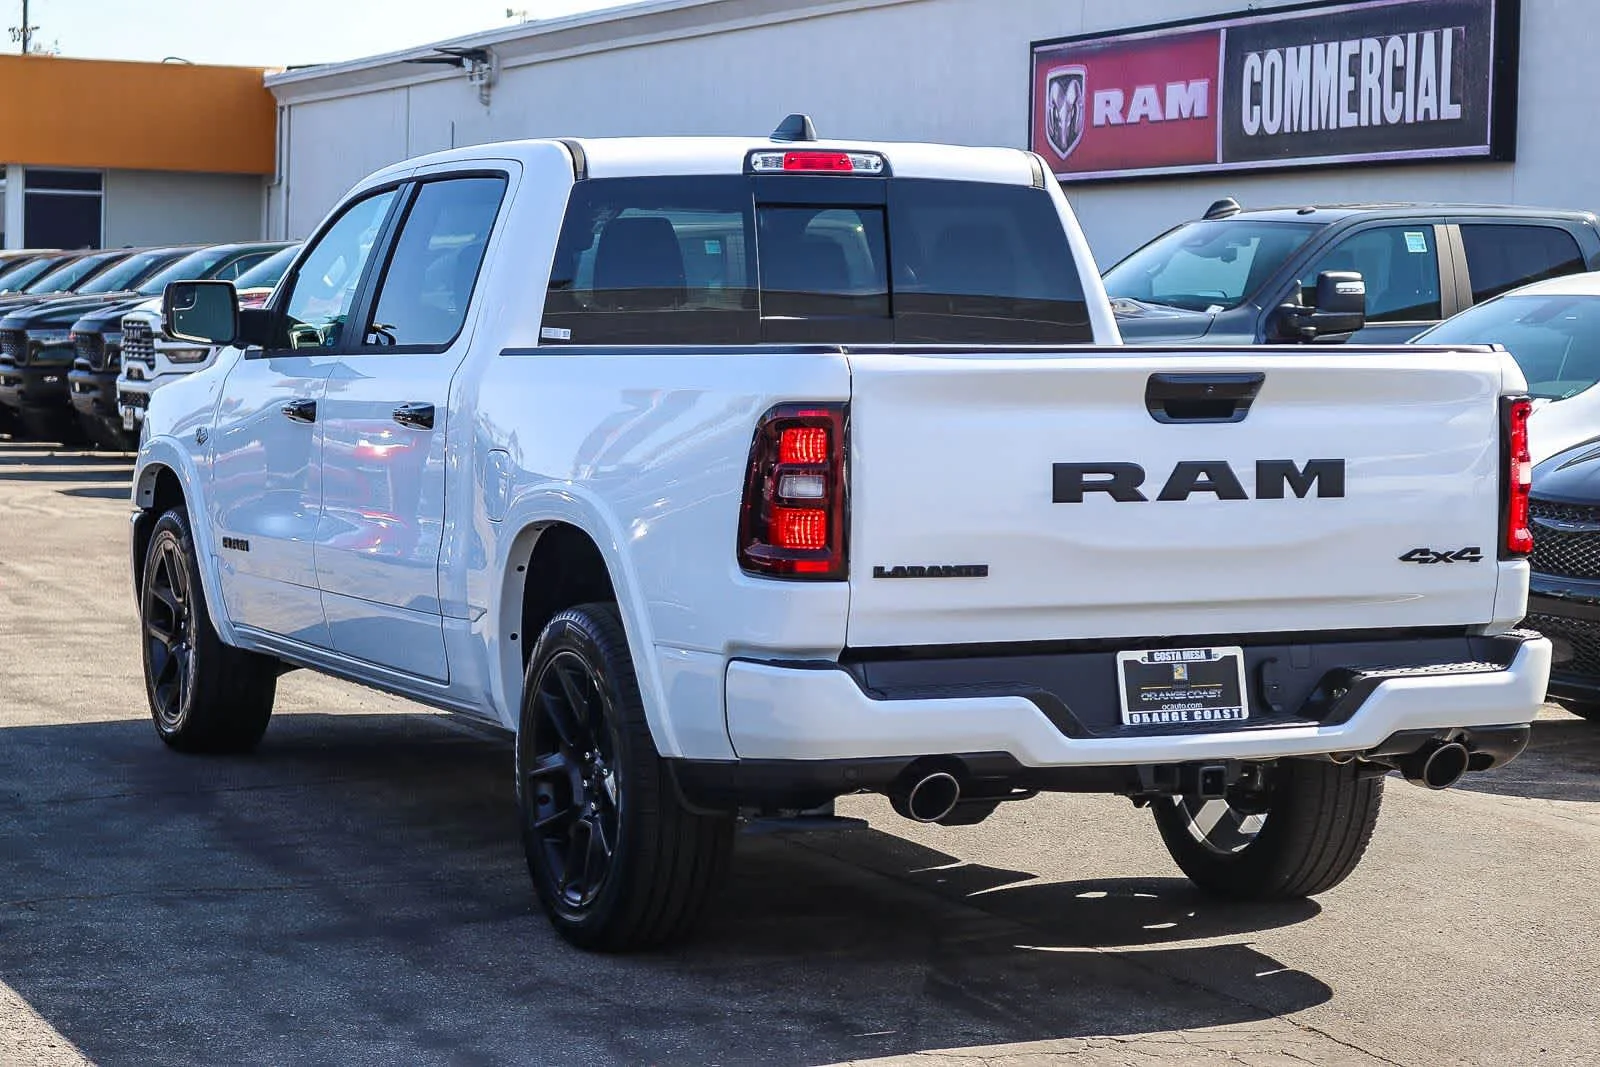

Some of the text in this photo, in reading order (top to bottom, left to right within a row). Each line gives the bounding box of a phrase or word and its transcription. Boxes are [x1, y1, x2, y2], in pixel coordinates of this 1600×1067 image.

[1092, 27, 1462, 136] RAM COMMERCIAL
[1052, 459, 1346, 503] RAM
[1398, 547, 1484, 564] 4x4
[1153, 649, 1206, 661] COSTA MESA
[1141, 688, 1223, 701] ORANGE COAST
[1161, 702, 1203, 711] ocauto.com
[1132, 708, 1239, 723] ORANGE COAST
